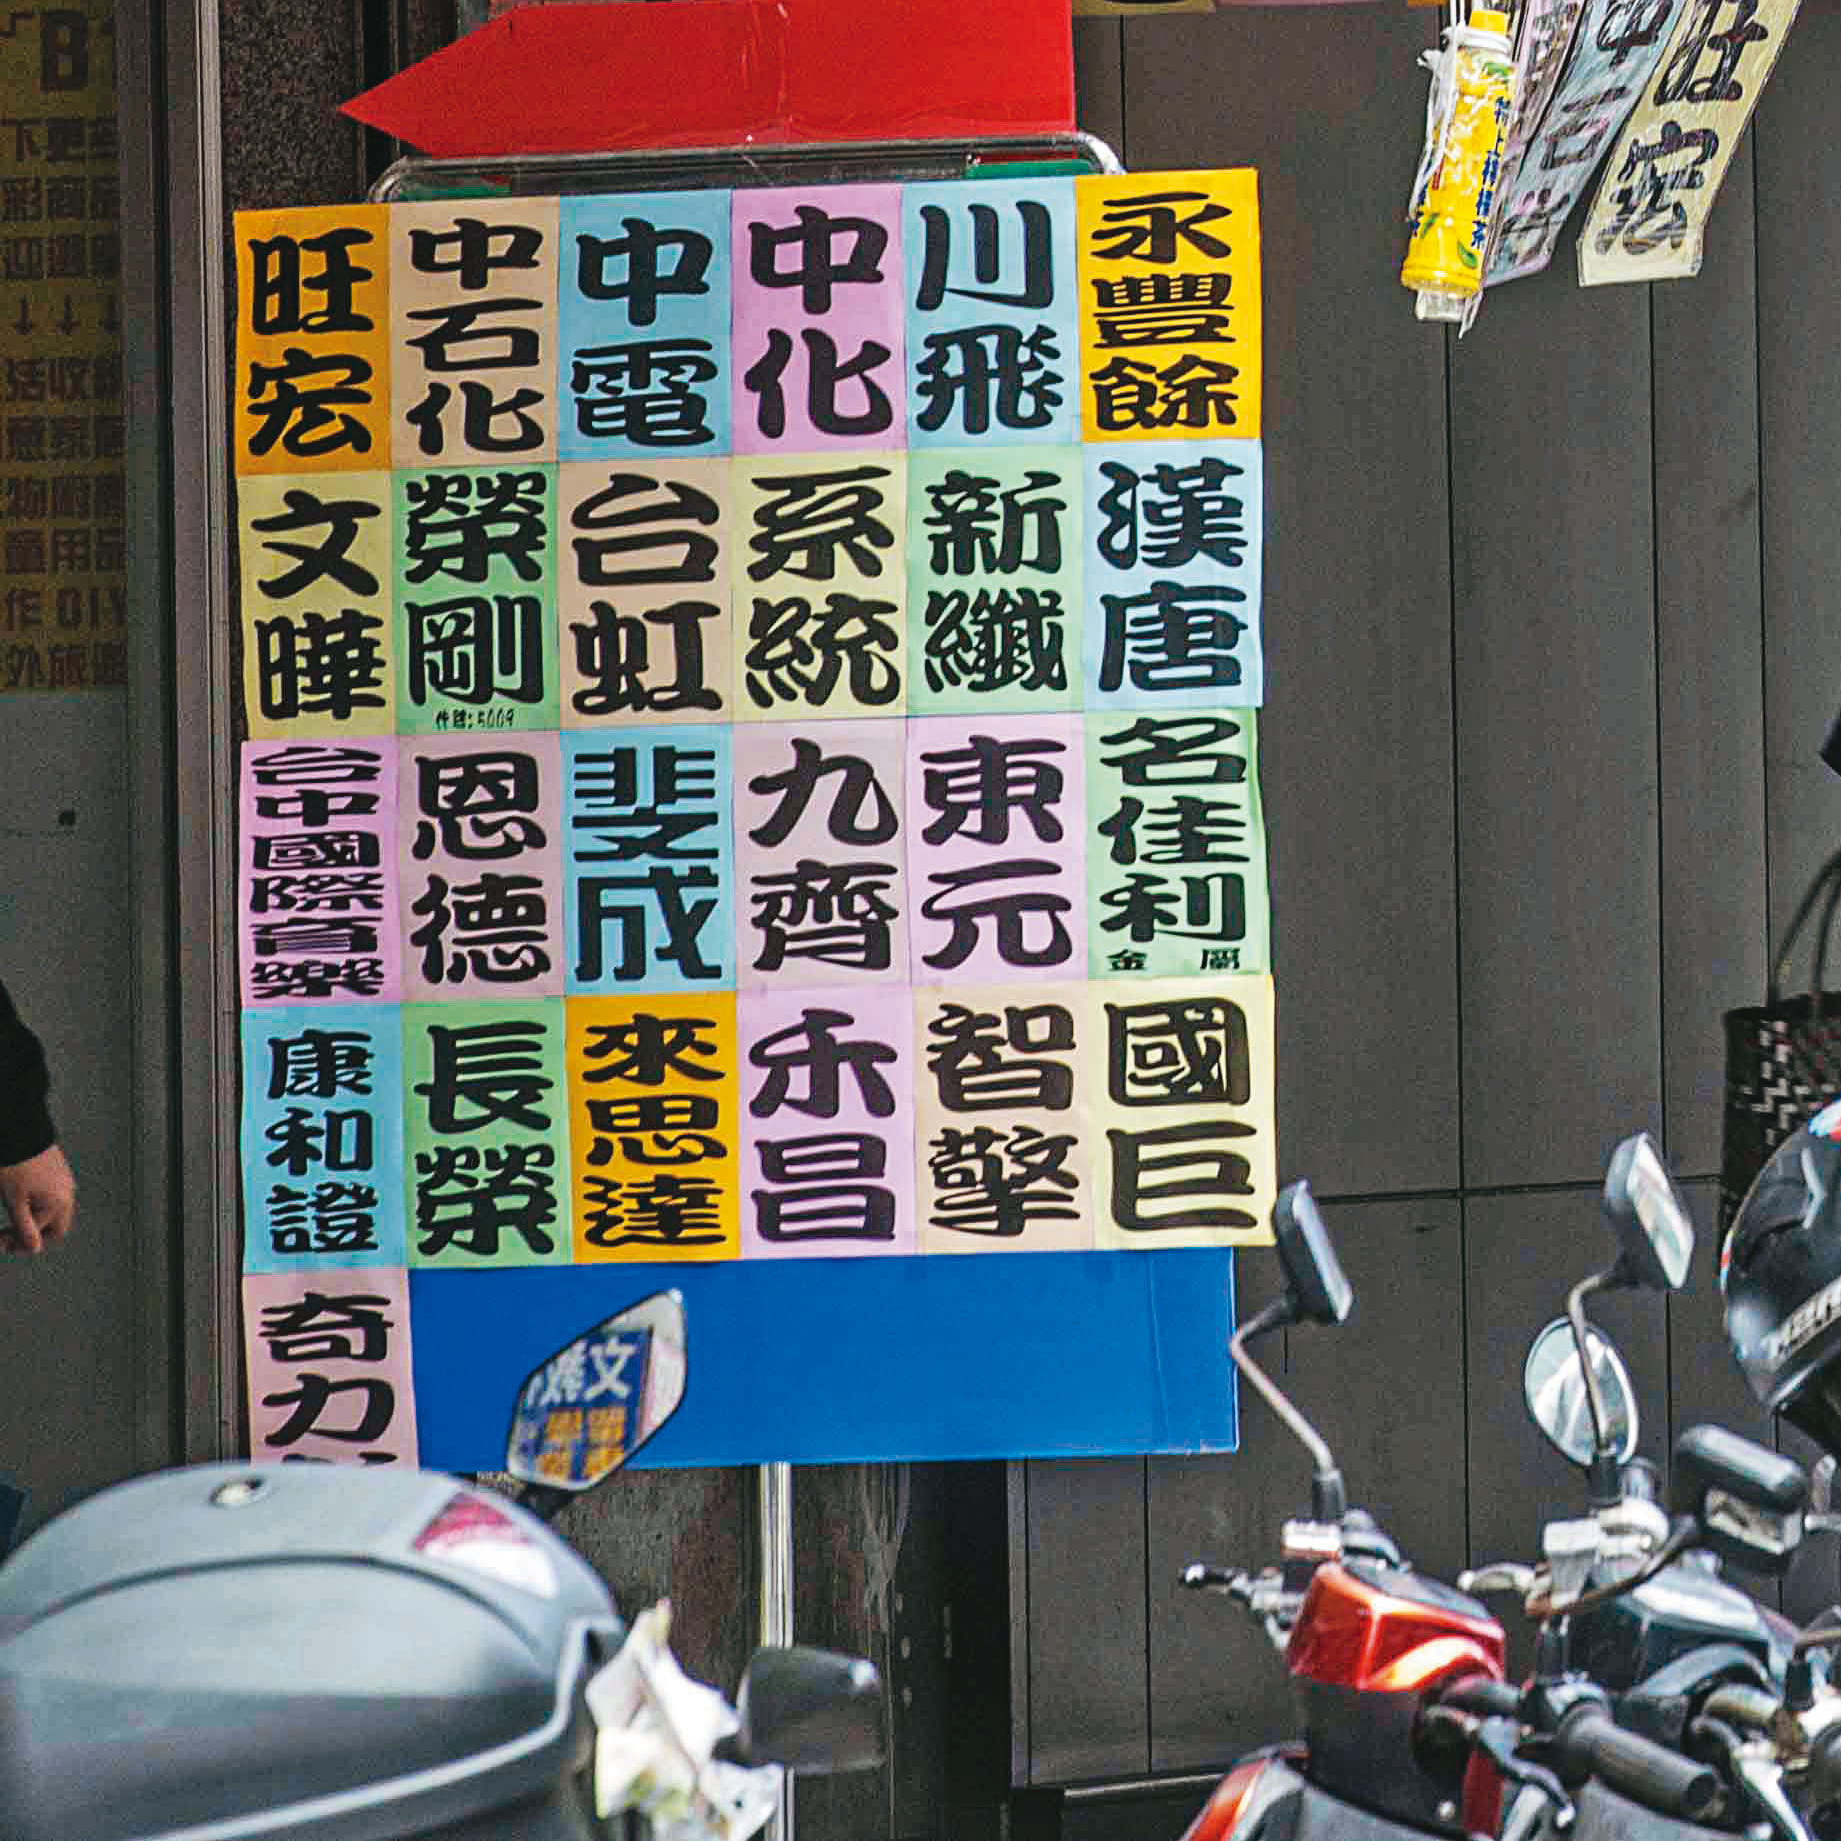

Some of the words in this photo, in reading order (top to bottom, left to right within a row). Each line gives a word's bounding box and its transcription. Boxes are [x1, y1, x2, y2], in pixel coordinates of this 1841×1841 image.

[247, 228, 374, 457] 旺宏
[406, 219, 544, 455] 中石化
[571, 218, 717, 447] 中電
[744, 206, 892, 439] 中化
[916, 201, 1064, 434] 川飛
[1090, 192, 1238, 431] 永豐餘
[250, 490, 386, 722] 文曄
[405, 472, 547, 704] 榮剛
[569, 474, 722, 715] 台虹
[746, 467, 900, 708] 系統
[923, 470, 1067, 692] 新纖
[1098, 458, 1248, 691] 漢唐
[411, 752, 550, 984] 恩德
[573, 746, 721, 981] 斐成
[749, 739, 898, 971] 九齊
[920, 736, 1072, 969] 東元
[1098, 718, 1250, 942] 名佳利
[265, 1029, 378, 1254] 康和證
[414, 1021, 557, 1255] 長榮
[582, 1014, 727, 1247] 來思達
[749, 1009, 897, 1241] 禾昌
[927, 1004, 1080, 1236] 智擎
[1104, 998, 1257, 1230] 國巨
[259, 1292, 398, 1465] 奇力
